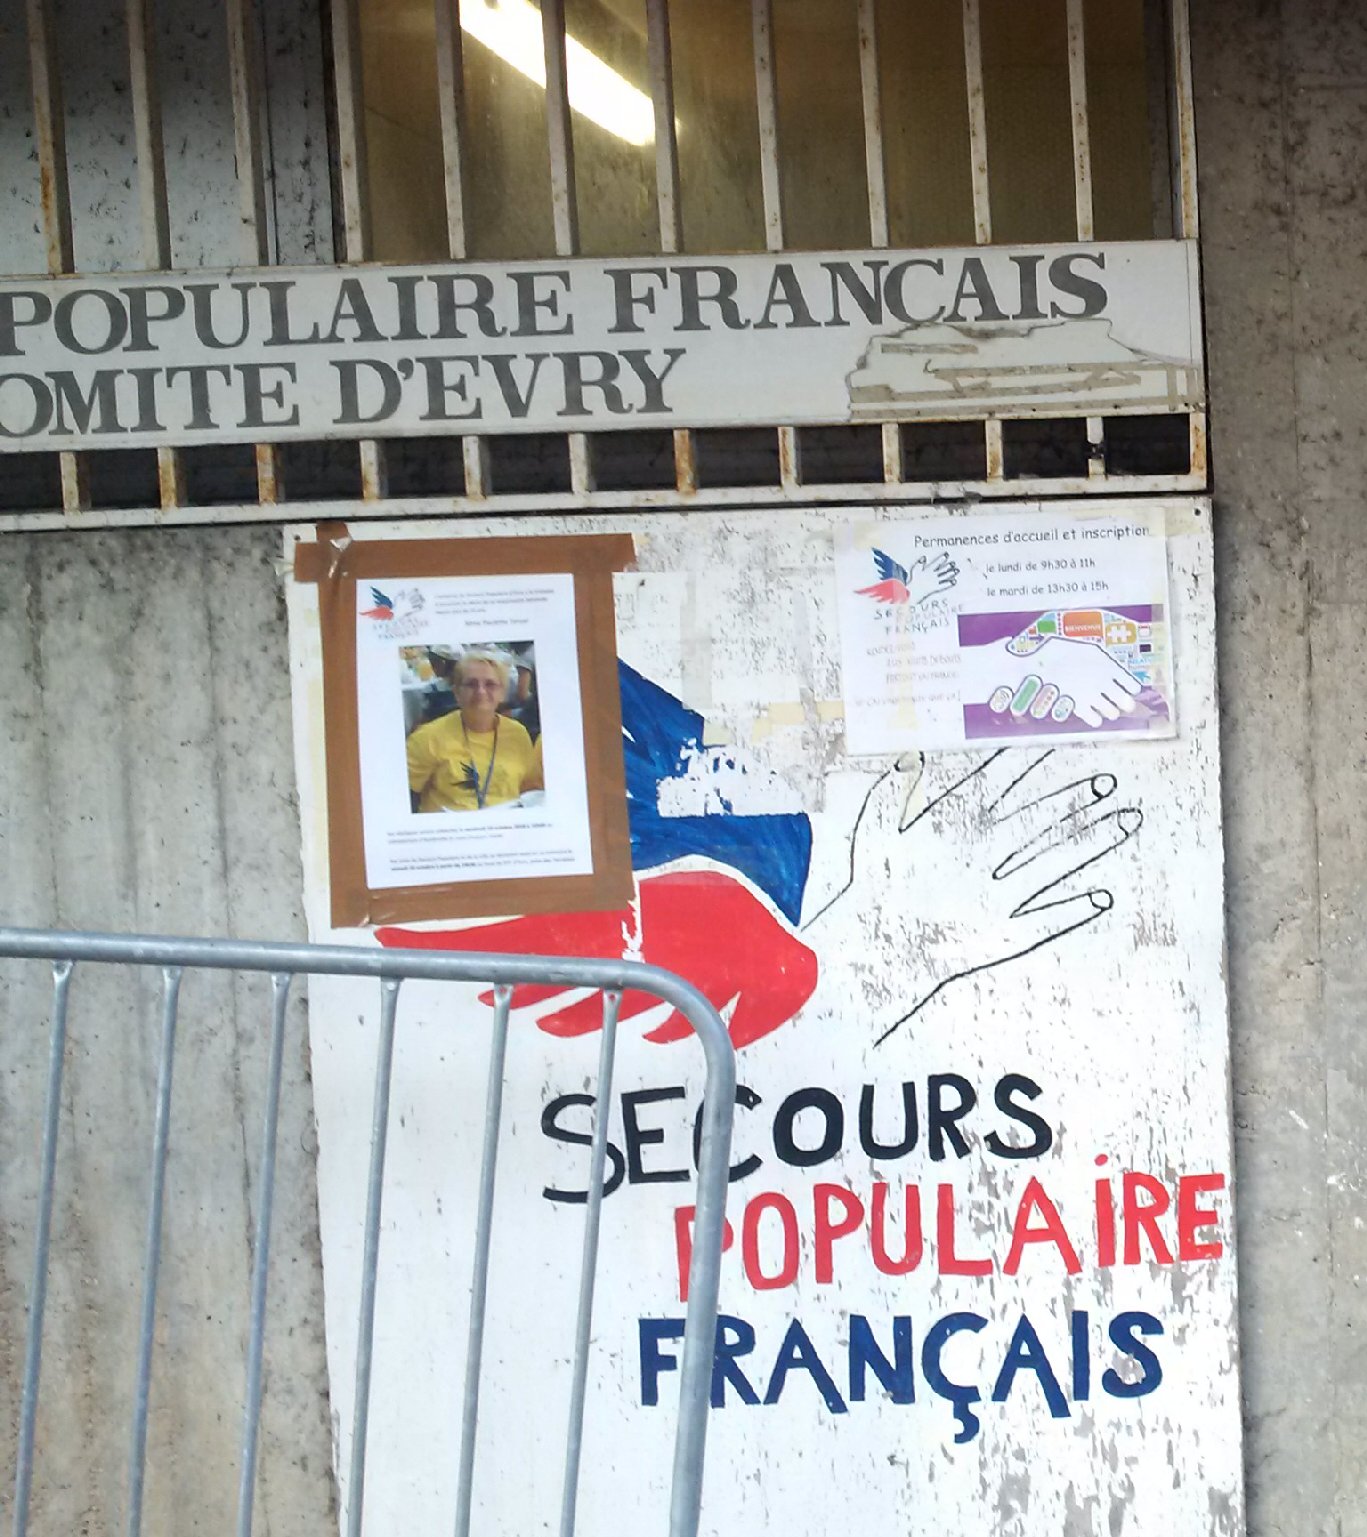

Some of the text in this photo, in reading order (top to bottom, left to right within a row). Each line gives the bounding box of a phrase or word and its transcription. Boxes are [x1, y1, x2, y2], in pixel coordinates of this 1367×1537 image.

[0, 270, 575, 357] POPULAIRE
[329, 348, 687, 425] D'EVRY
[914, 524, 1151, 548] Permanences d'accueil et inscription
[986, 564, 995, 573] le
[998, 561, 1022, 573] lundi
[1026, 560, 1038, 571] de
[1041, 558, 1068, 570] 9h30
[1080, 557, 1096, 568] 11h
[987, 587, 996, 597] le
[1000, 585, 1029, 596] mardi
[1032, 585, 1045, 595] de
[1048, 582, 1079, 594] 13h30
[541, 1073, 1054, 1203] SECOURS
[638, 1311, 1163, 1444] FRANÇAIS
